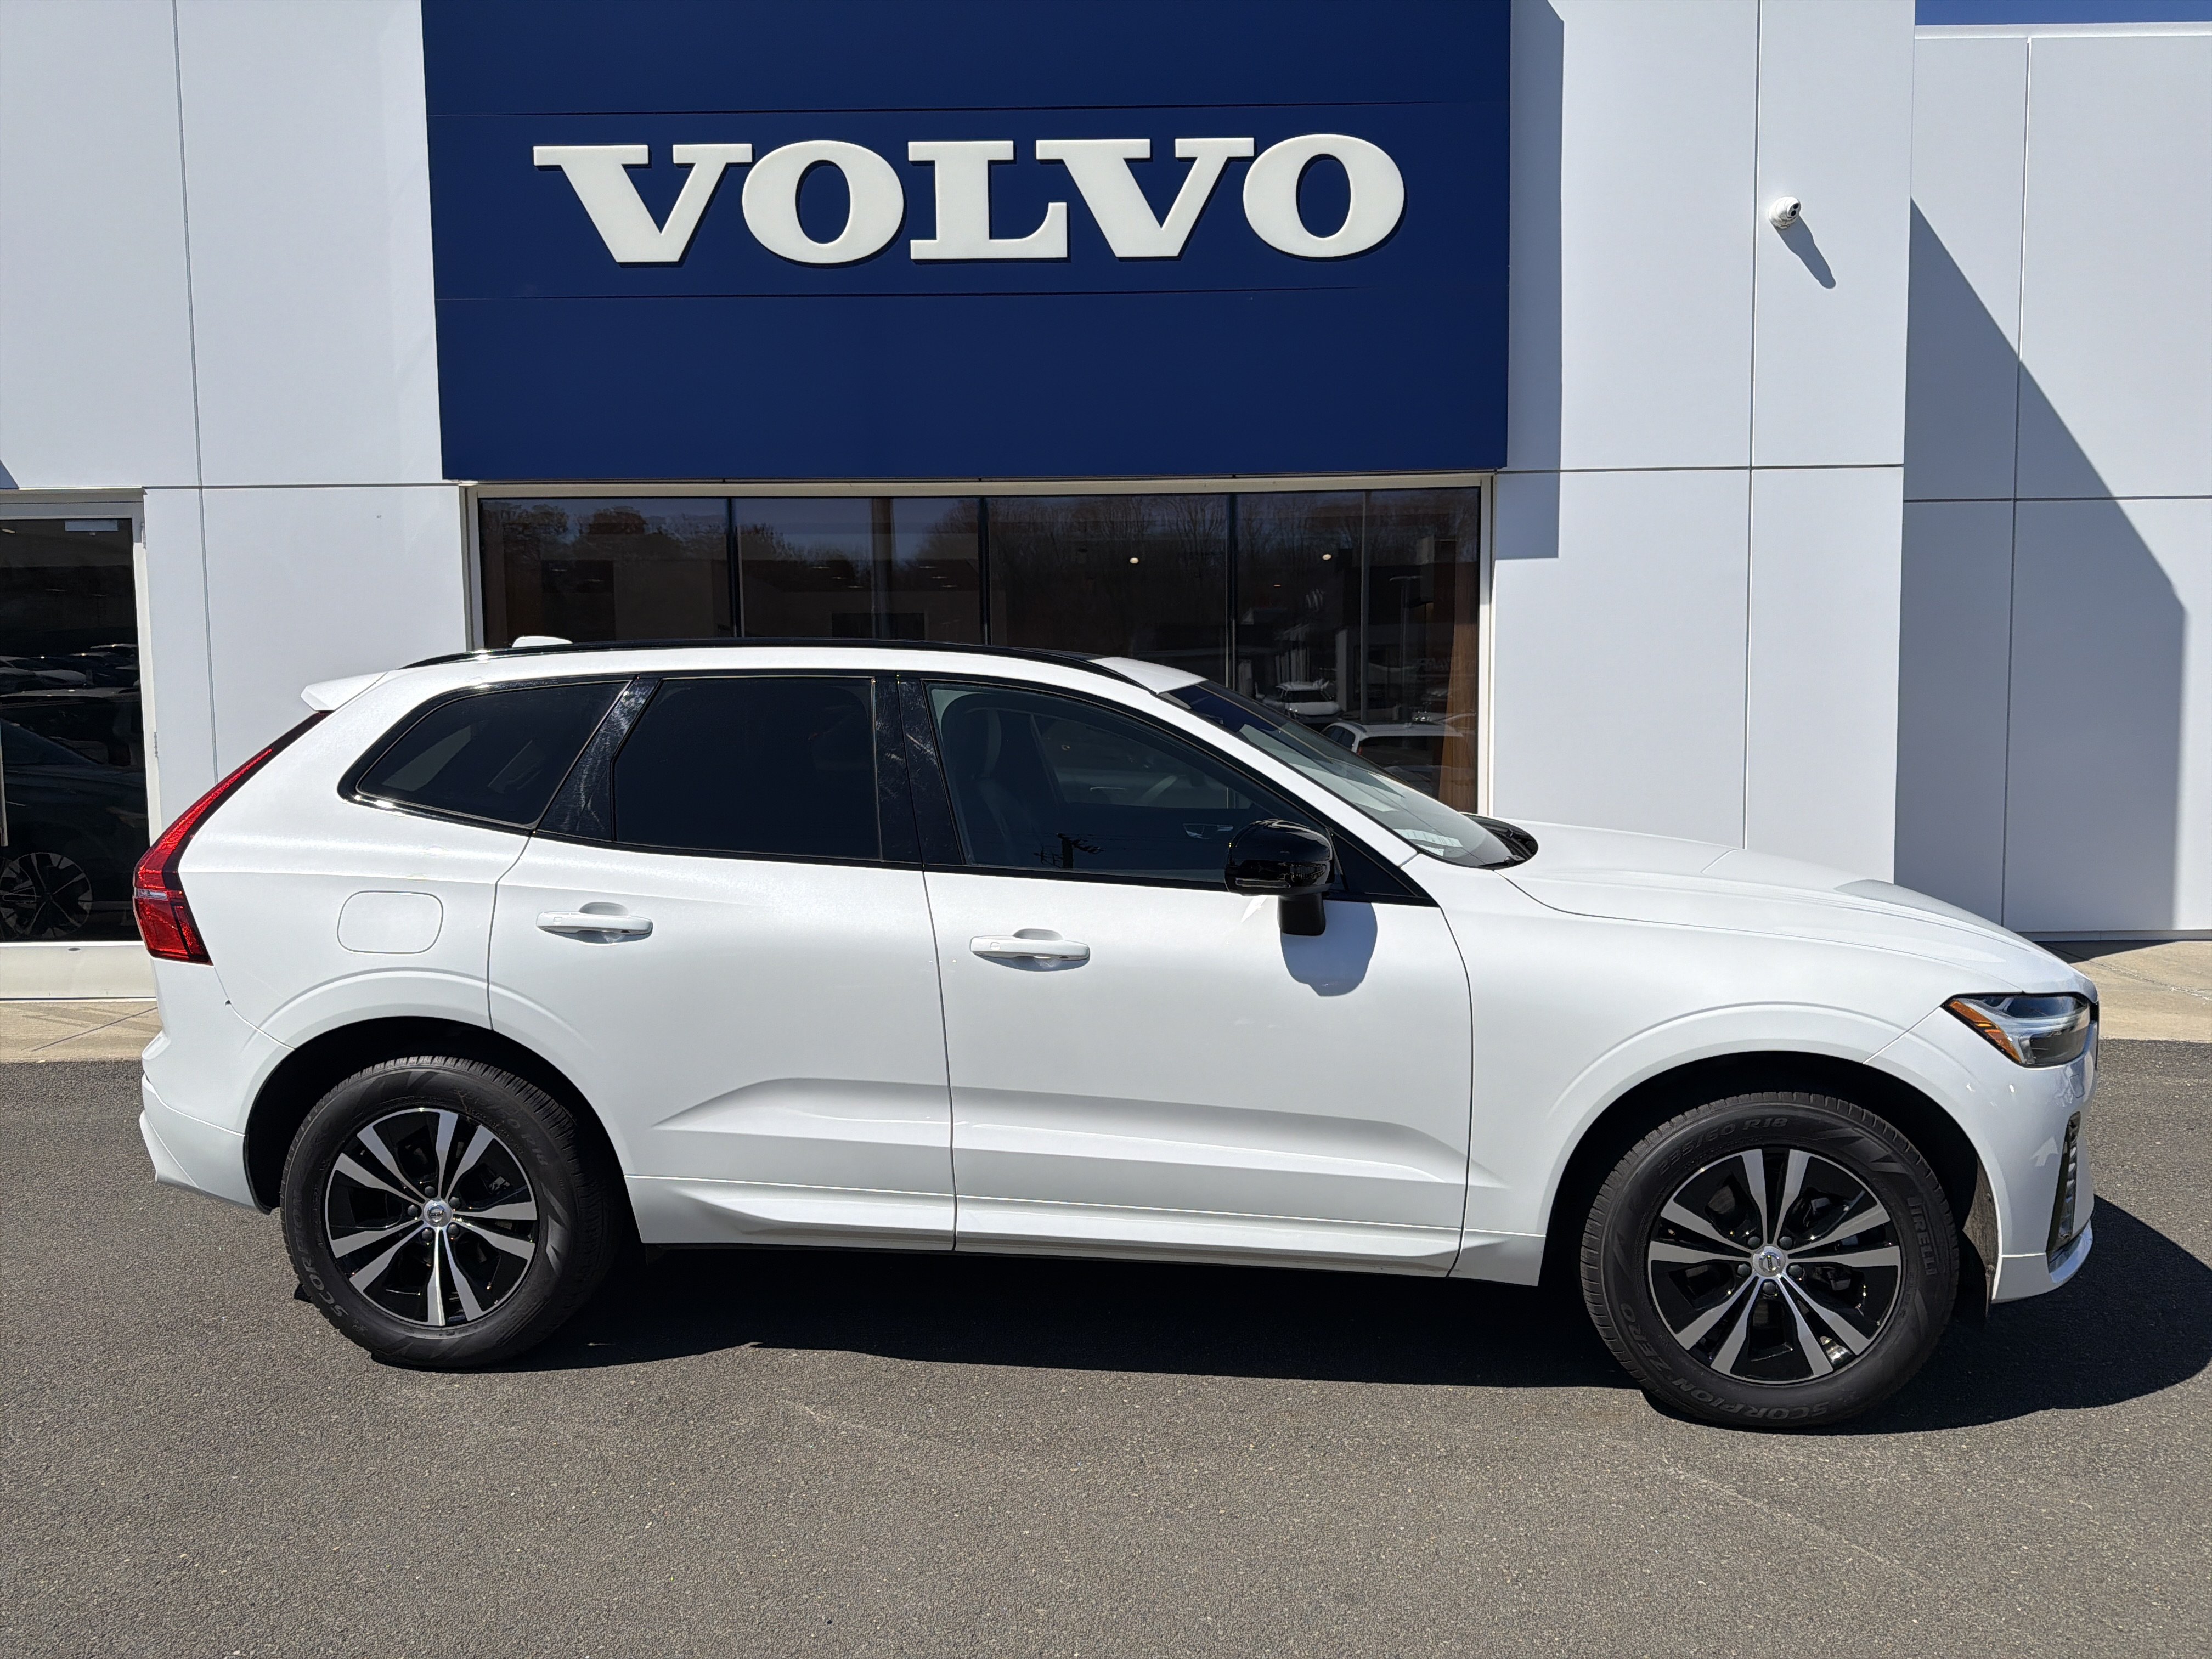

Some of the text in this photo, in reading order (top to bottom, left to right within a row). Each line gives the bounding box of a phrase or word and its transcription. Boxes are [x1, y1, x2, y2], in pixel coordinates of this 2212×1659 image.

[533, 134, 1404, 263] VOLVO
[1658, 1123, 1736, 1176] 235/60
[1742, 1117, 1788, 1131] R18
[291, 1188, 350, 1318] SCORPION
[1906, 1196, 1943, 1276] PIRELLI
[1620, 1302, 1830, 1420] SCORPION ZERO
